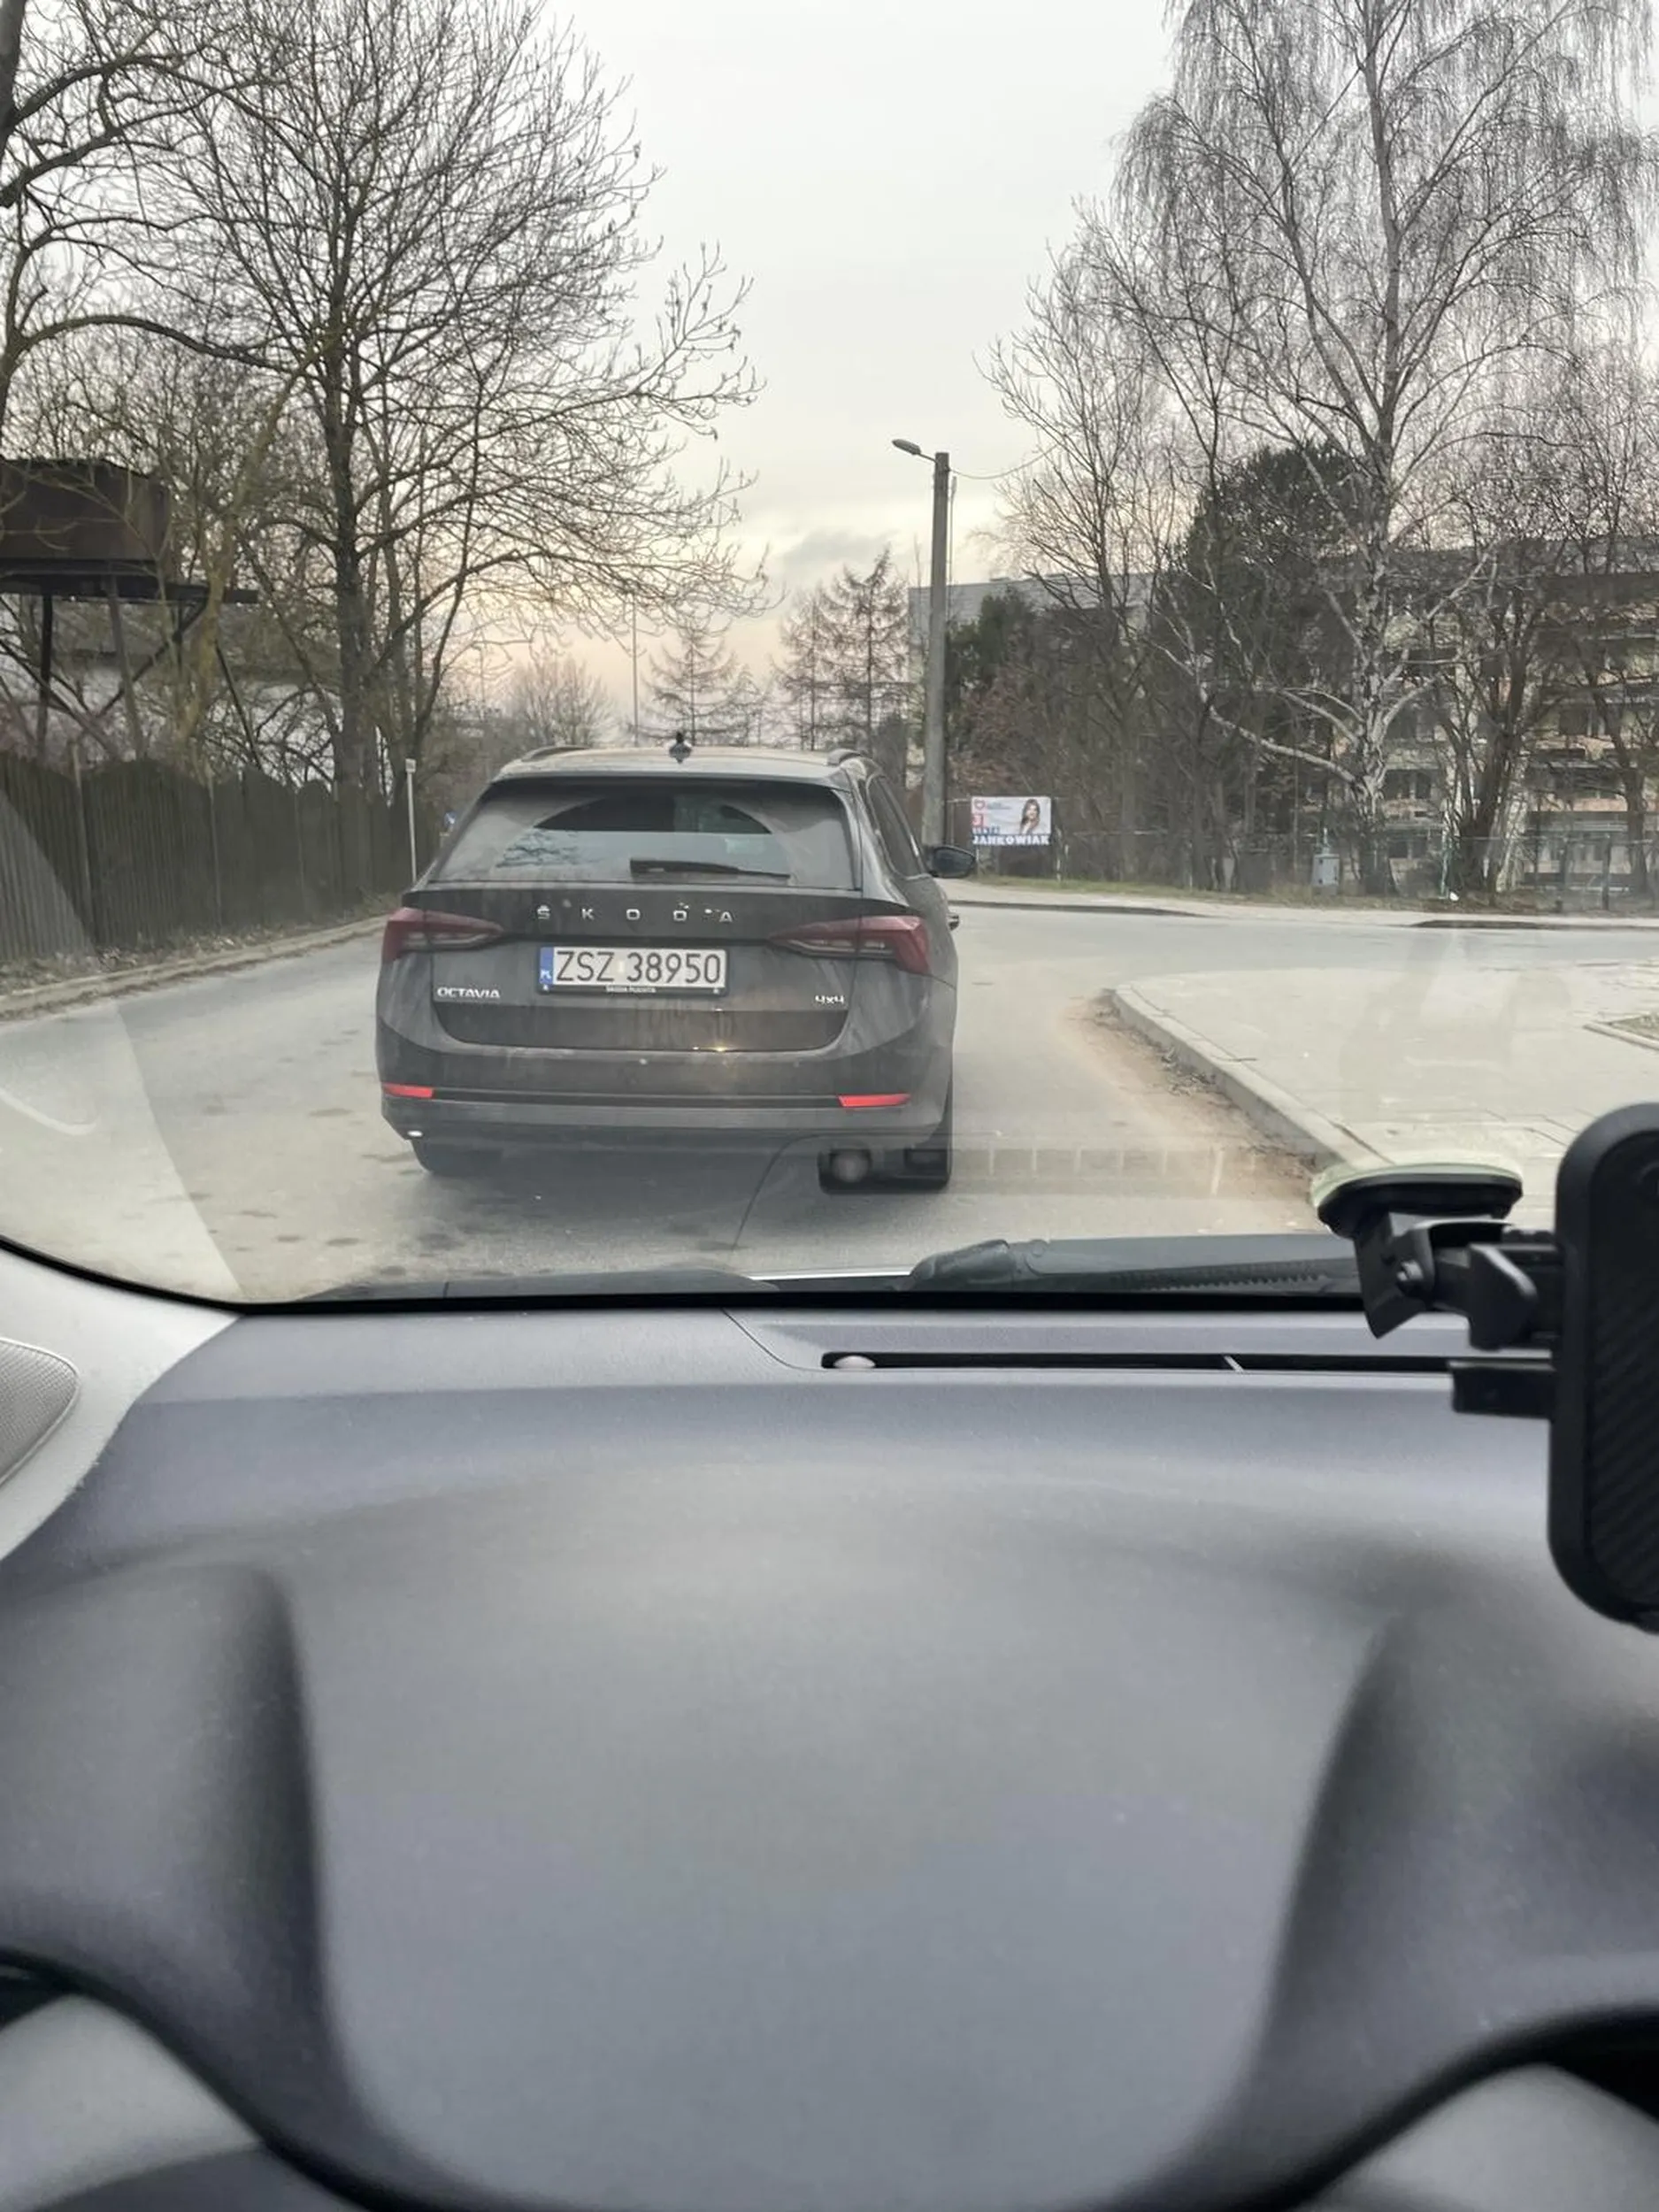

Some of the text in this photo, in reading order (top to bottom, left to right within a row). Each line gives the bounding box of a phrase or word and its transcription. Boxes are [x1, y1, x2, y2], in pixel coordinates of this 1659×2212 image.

[557, 950, 721, 984] ZSZ 38950
[437, 987, 501, 998] OCTAVIA
